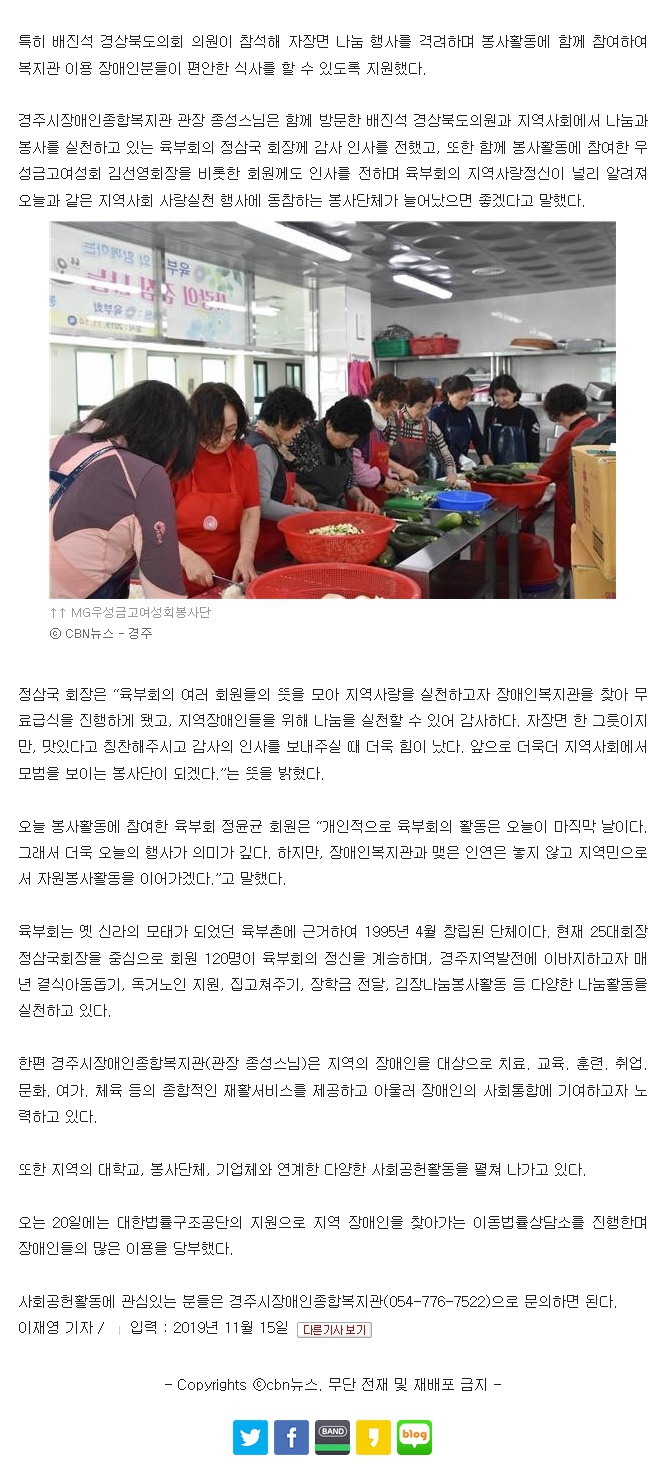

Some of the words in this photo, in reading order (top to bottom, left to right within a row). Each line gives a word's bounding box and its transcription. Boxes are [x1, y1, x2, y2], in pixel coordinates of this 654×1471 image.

[72, 607, 211, 618] MG우성금고여성회봉사단
[66, 628, 113, 639] CBN뉴스
[129, 628, 152, 639] 경주
[19, 767, 59, 780] 모범을
[66, 767, 106, 780] 보이는
[113, 767, 166, 780] 봉사단이
[174, 767, 239, 780] 되겠다.”는
[246, 767, 272, 780] 뜻을
[279, 767, 323, 780] 밝혔다.
[19, 1295, 114, 1308] 사회공헌활동에
[122, 1295, 176, 1308] 관심있는
[183, 1295, 223, 1308] 분들은
[230, 1295, 518, 1308] 경주시장애인종합복지관(054-776-7522)으로
[525, 1295, 578, 1308] 문의하면
[586, 1295, 616, 1308] 된다.
[19, 1321, 58, 1335] 이재영
[66, 1321, 92, 1335] 기자
[131, 1321, 156, 1335] 입력
[174, 1321, 218, 1335] 2019년
[226, 1321, 252, 1335] 11월
[261, 1321, 288, 1335] 15일
[178, 1379, 246, 1391] Copyrights
[253, 1378, 321, 1391] ⓒcbn뉴스,
[329, 1378, 356, 1391] 무단
[362, 1378, 387, 1391] 전재
[395, 1378, 407, 1391] 및
[414, 1378, 454, 1391] 재배포
[461, 1378, 486, 1391] 금지
[322, 1427, 345, 1436] BAND
[402, 1429, 427, 1441] blog
